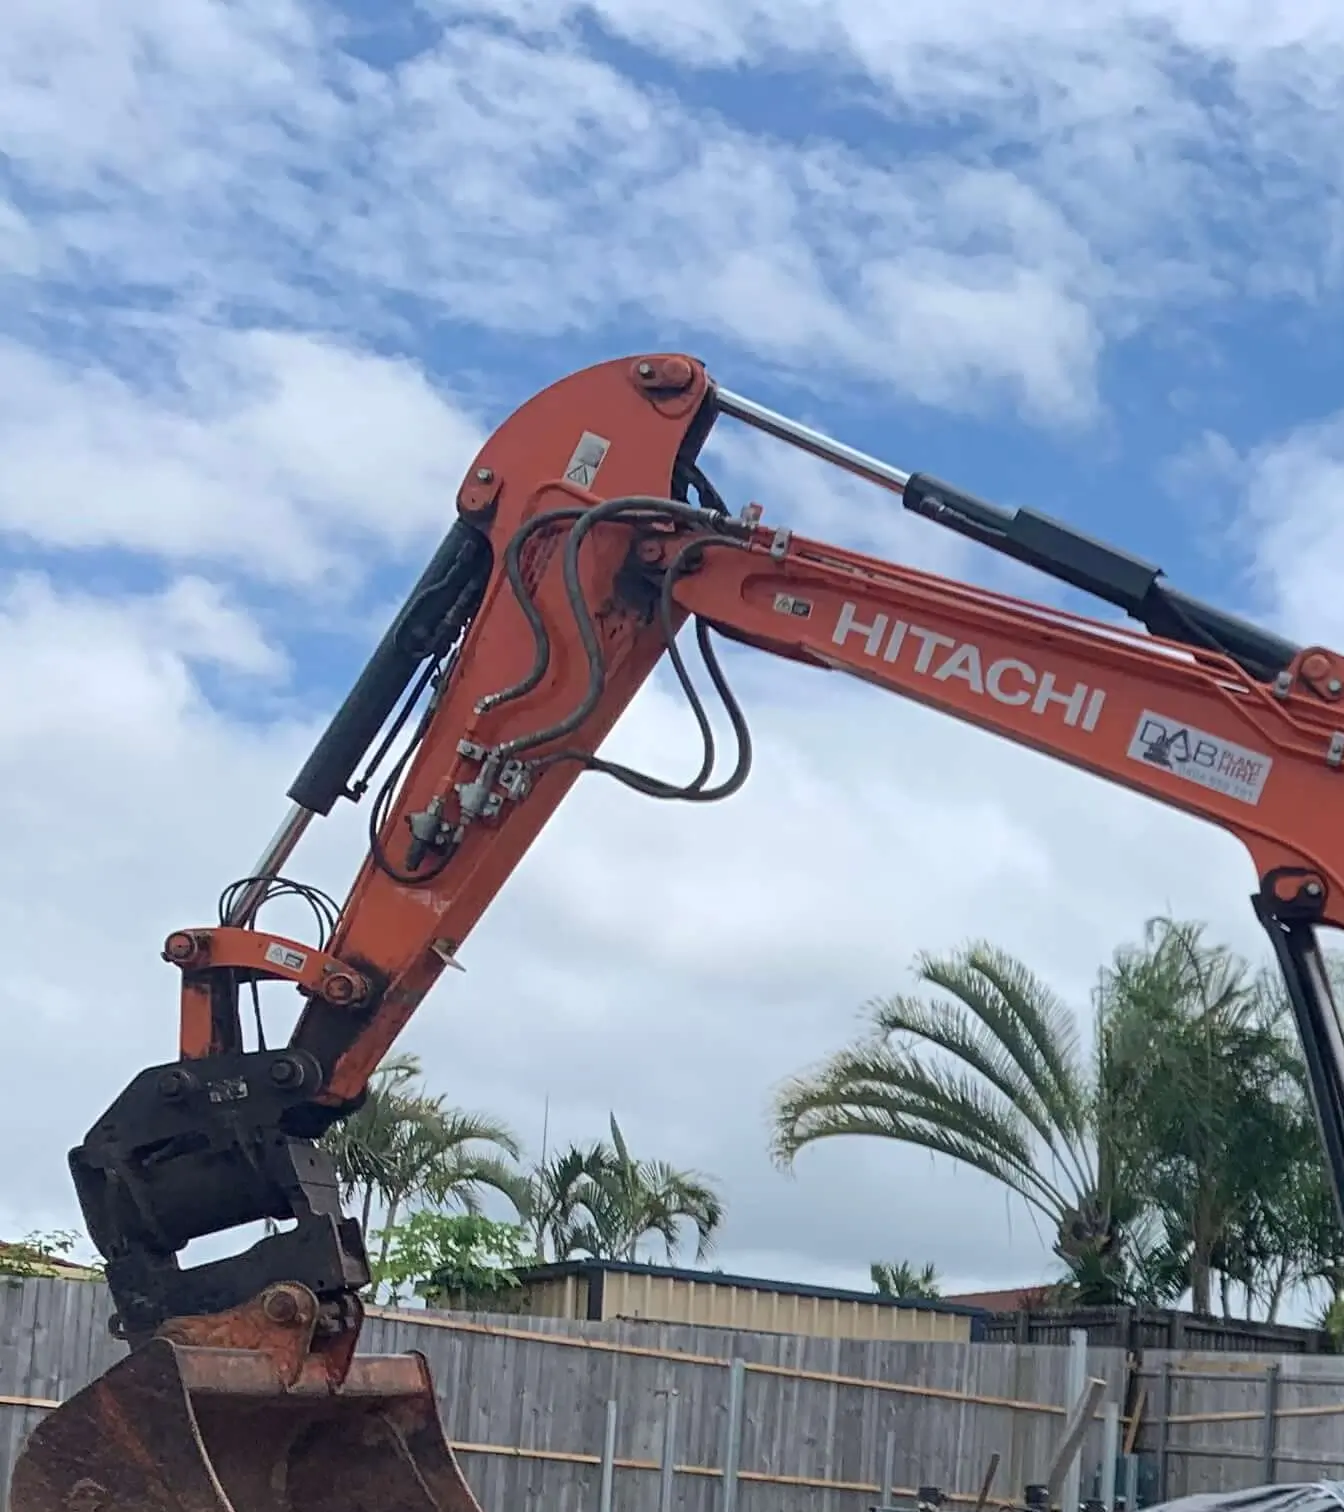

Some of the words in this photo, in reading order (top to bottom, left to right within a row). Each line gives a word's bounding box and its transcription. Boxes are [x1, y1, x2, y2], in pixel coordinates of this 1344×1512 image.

[832, 601, 1106, 733] HITACHI
[1139, 719, 1219, 769] DAB
[1220, 750, 1263, 776] PLANT
[1217, 760, 1258, 786] HIRE
